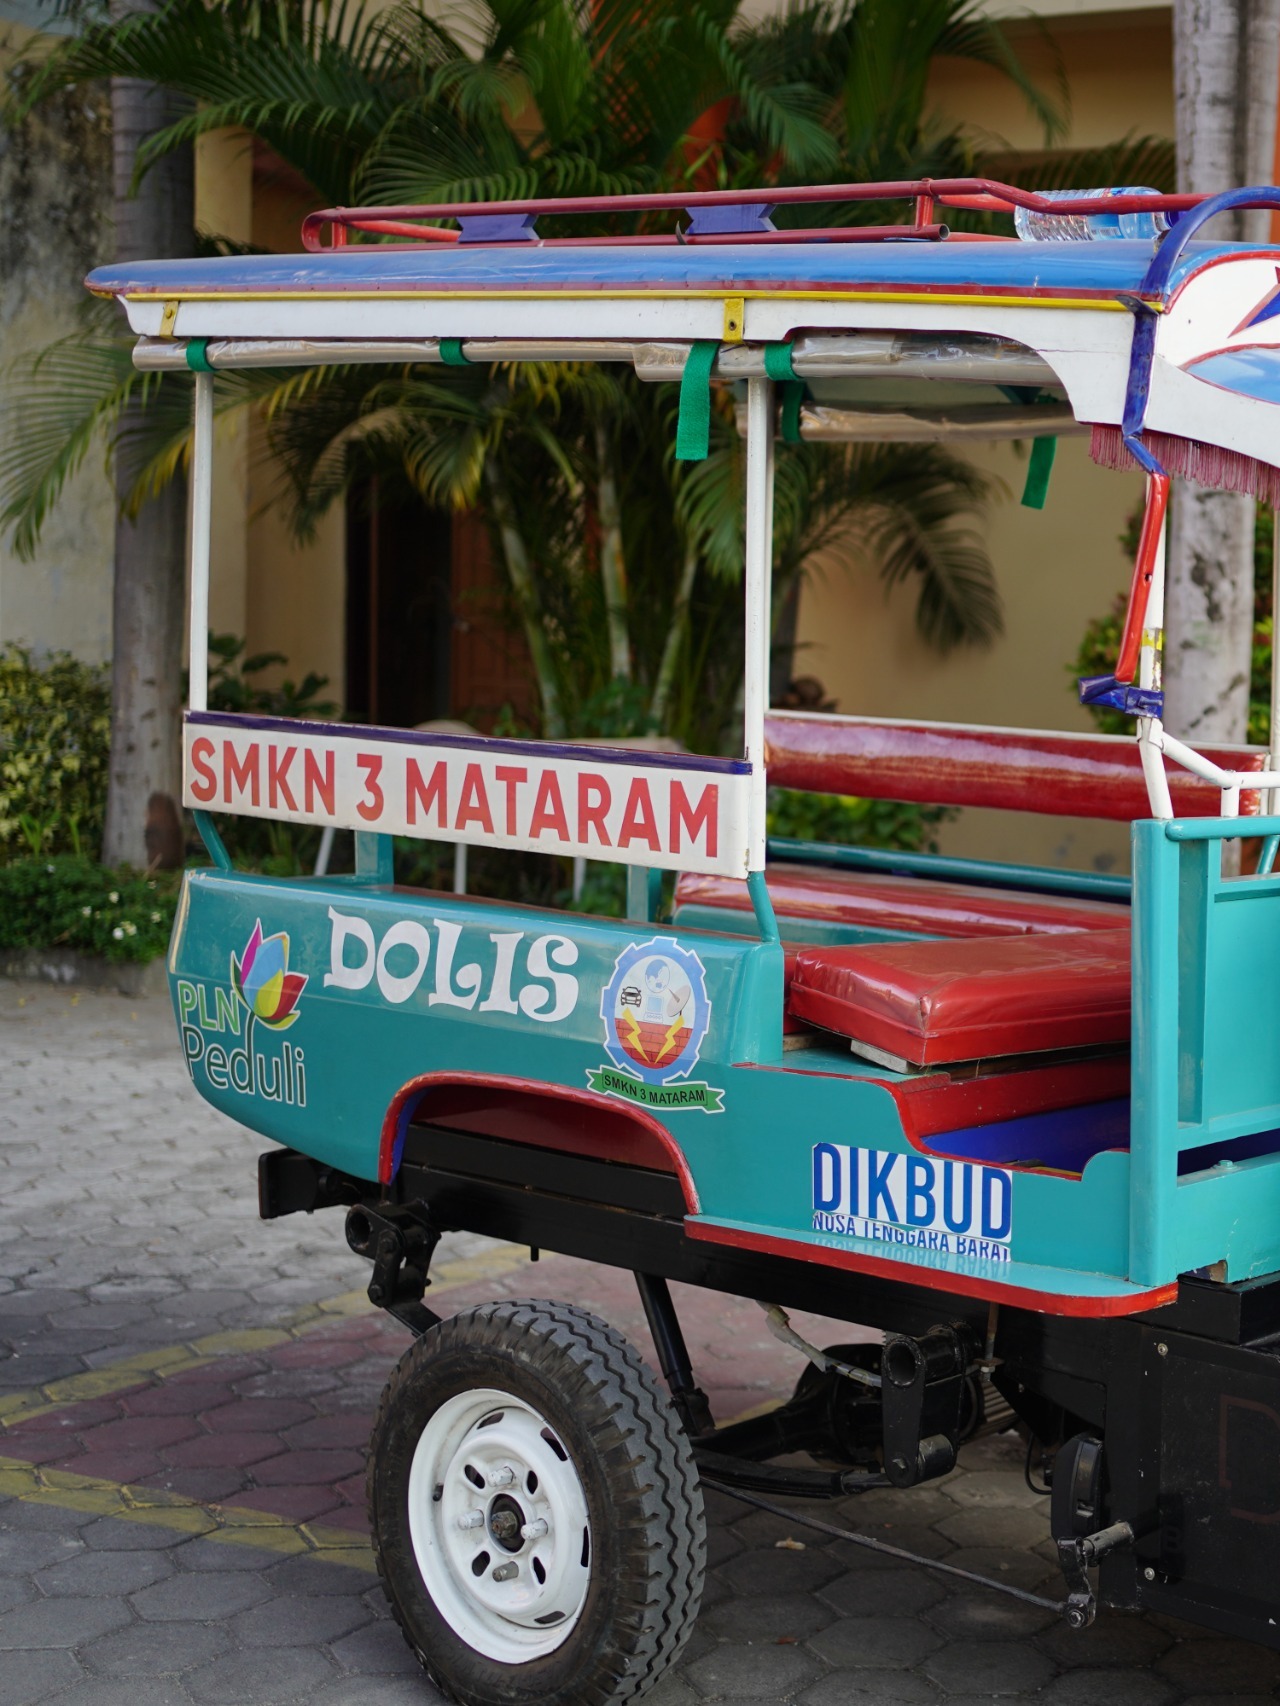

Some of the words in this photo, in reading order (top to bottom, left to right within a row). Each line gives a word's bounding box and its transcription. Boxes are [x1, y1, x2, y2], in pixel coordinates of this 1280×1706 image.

[190, 737, 336, 816] SMKN
[356, 753, 384, 821] 3
[406, 758, 719, 858] MATARAM
[324, 906, 579, 1022] DOLIS
[178, 980, 240, 1035] PLN
[182, 1024, 306, 1107] Peduli
[604, 1075, 638, 1097] SMKN
[640, 1088, 647, 1100] 3
[649, 1089, 705, 1105] MATARAM
[813, 1142, 1012, 1239] DIKBUD
[813, 1211, 856, 1236] NUSA
